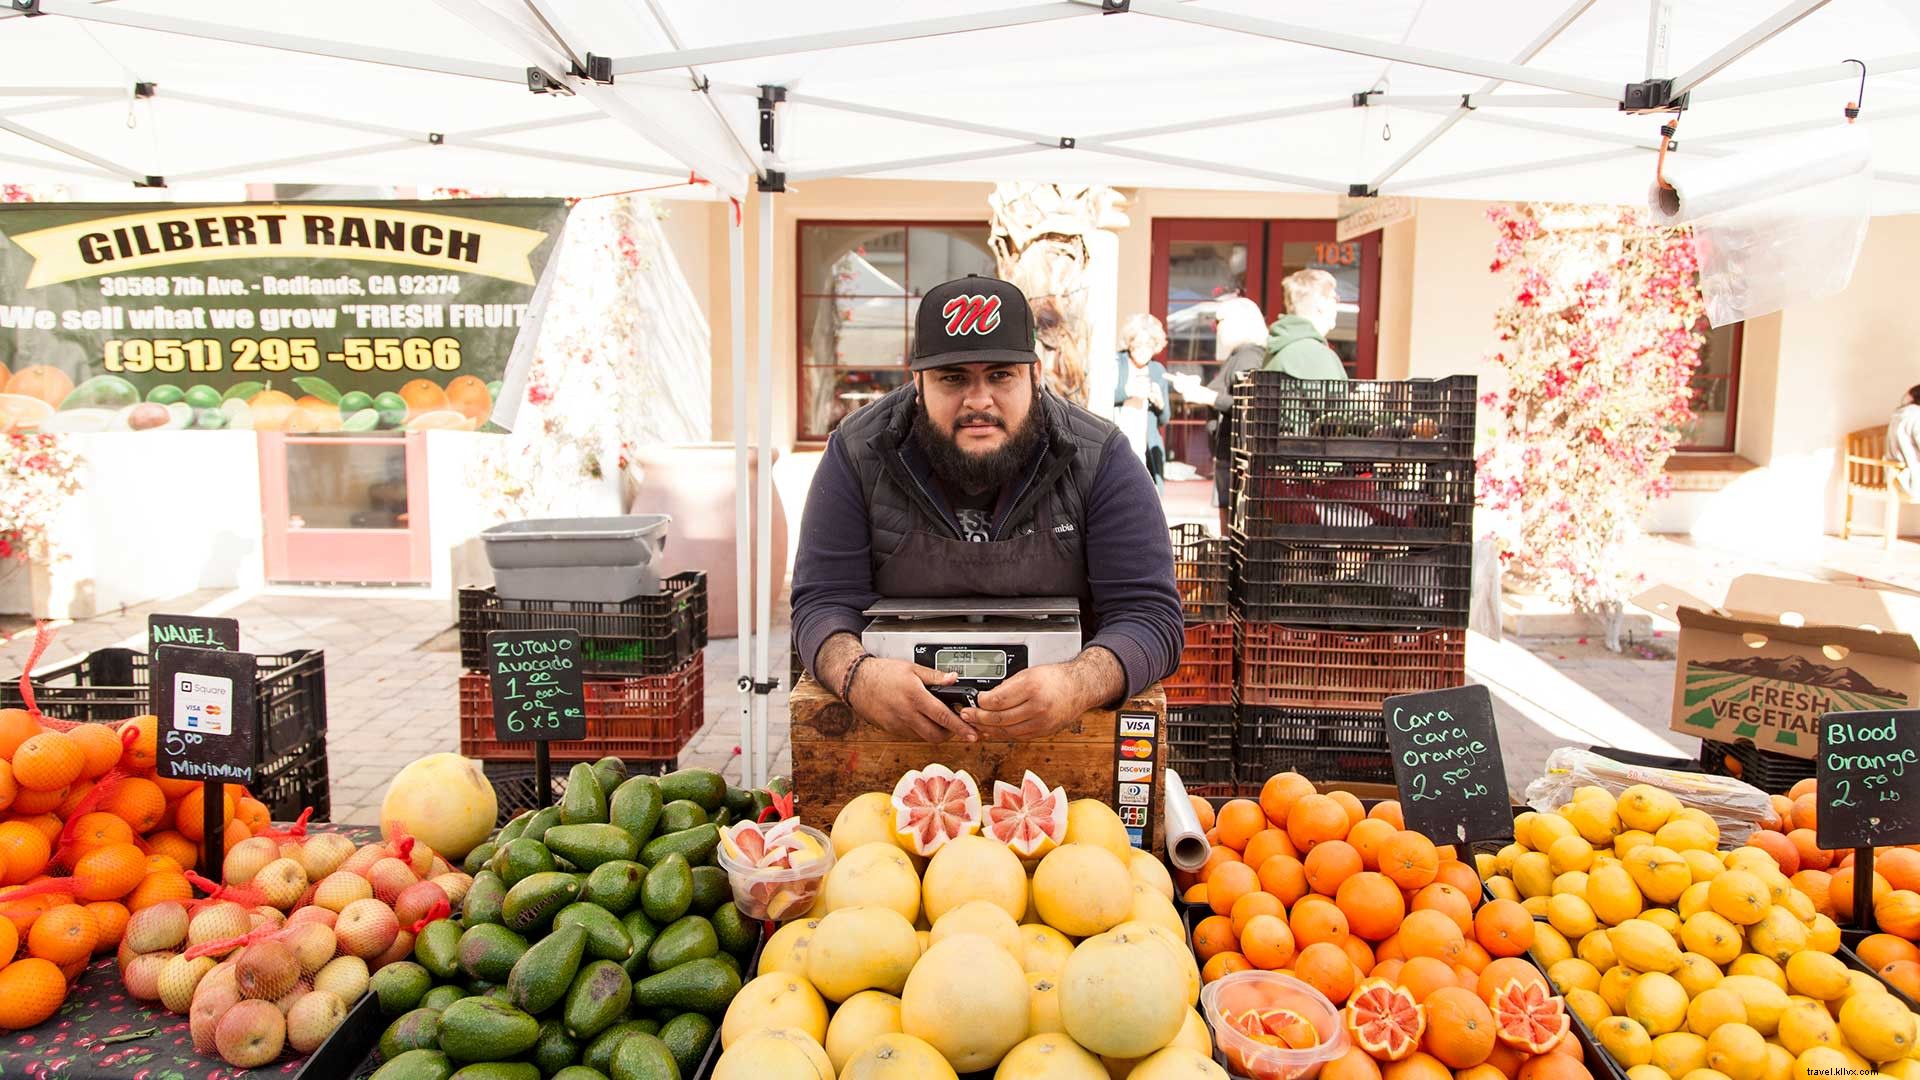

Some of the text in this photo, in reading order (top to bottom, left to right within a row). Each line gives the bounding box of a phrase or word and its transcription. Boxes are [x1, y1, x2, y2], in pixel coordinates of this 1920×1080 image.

[79, 214, 481, 264] GILBERT RANCH
[1315, 241, 1354, 266] 103
[100, 276, 170, 297] 30588
[172, 276, 204, 296] 7th
[207, 276, 249, 296] Ave.
[263, 275, 366, 298] Redlands,
[368, 275, 398, 295] CA
[400, 275, 460, 295] 92374
[0, 306, 56, 330] We
[62, 306, 124, 330] sell
[128, 306, 207, 330] what
[209, 308, 255, 329] we
[260, 308, 337, 331] grow
[104, 336, 463, 373] (951) 295 -5566
[493, 639, 573, 657] ZUTANO
[194, 683, 226, 695] Square
[1751, 685, 1831, 713] FRESH
[507, 711, 524, 732] 6
[1126, 721, 1150, 731] VISA
[1393, 707, 1454, 732] Cara
[1827, 718, 1897, 745] Blood
[1413, 727, 1468, 745] cara
[1120, 765, 1151, 774] DISCOVER
